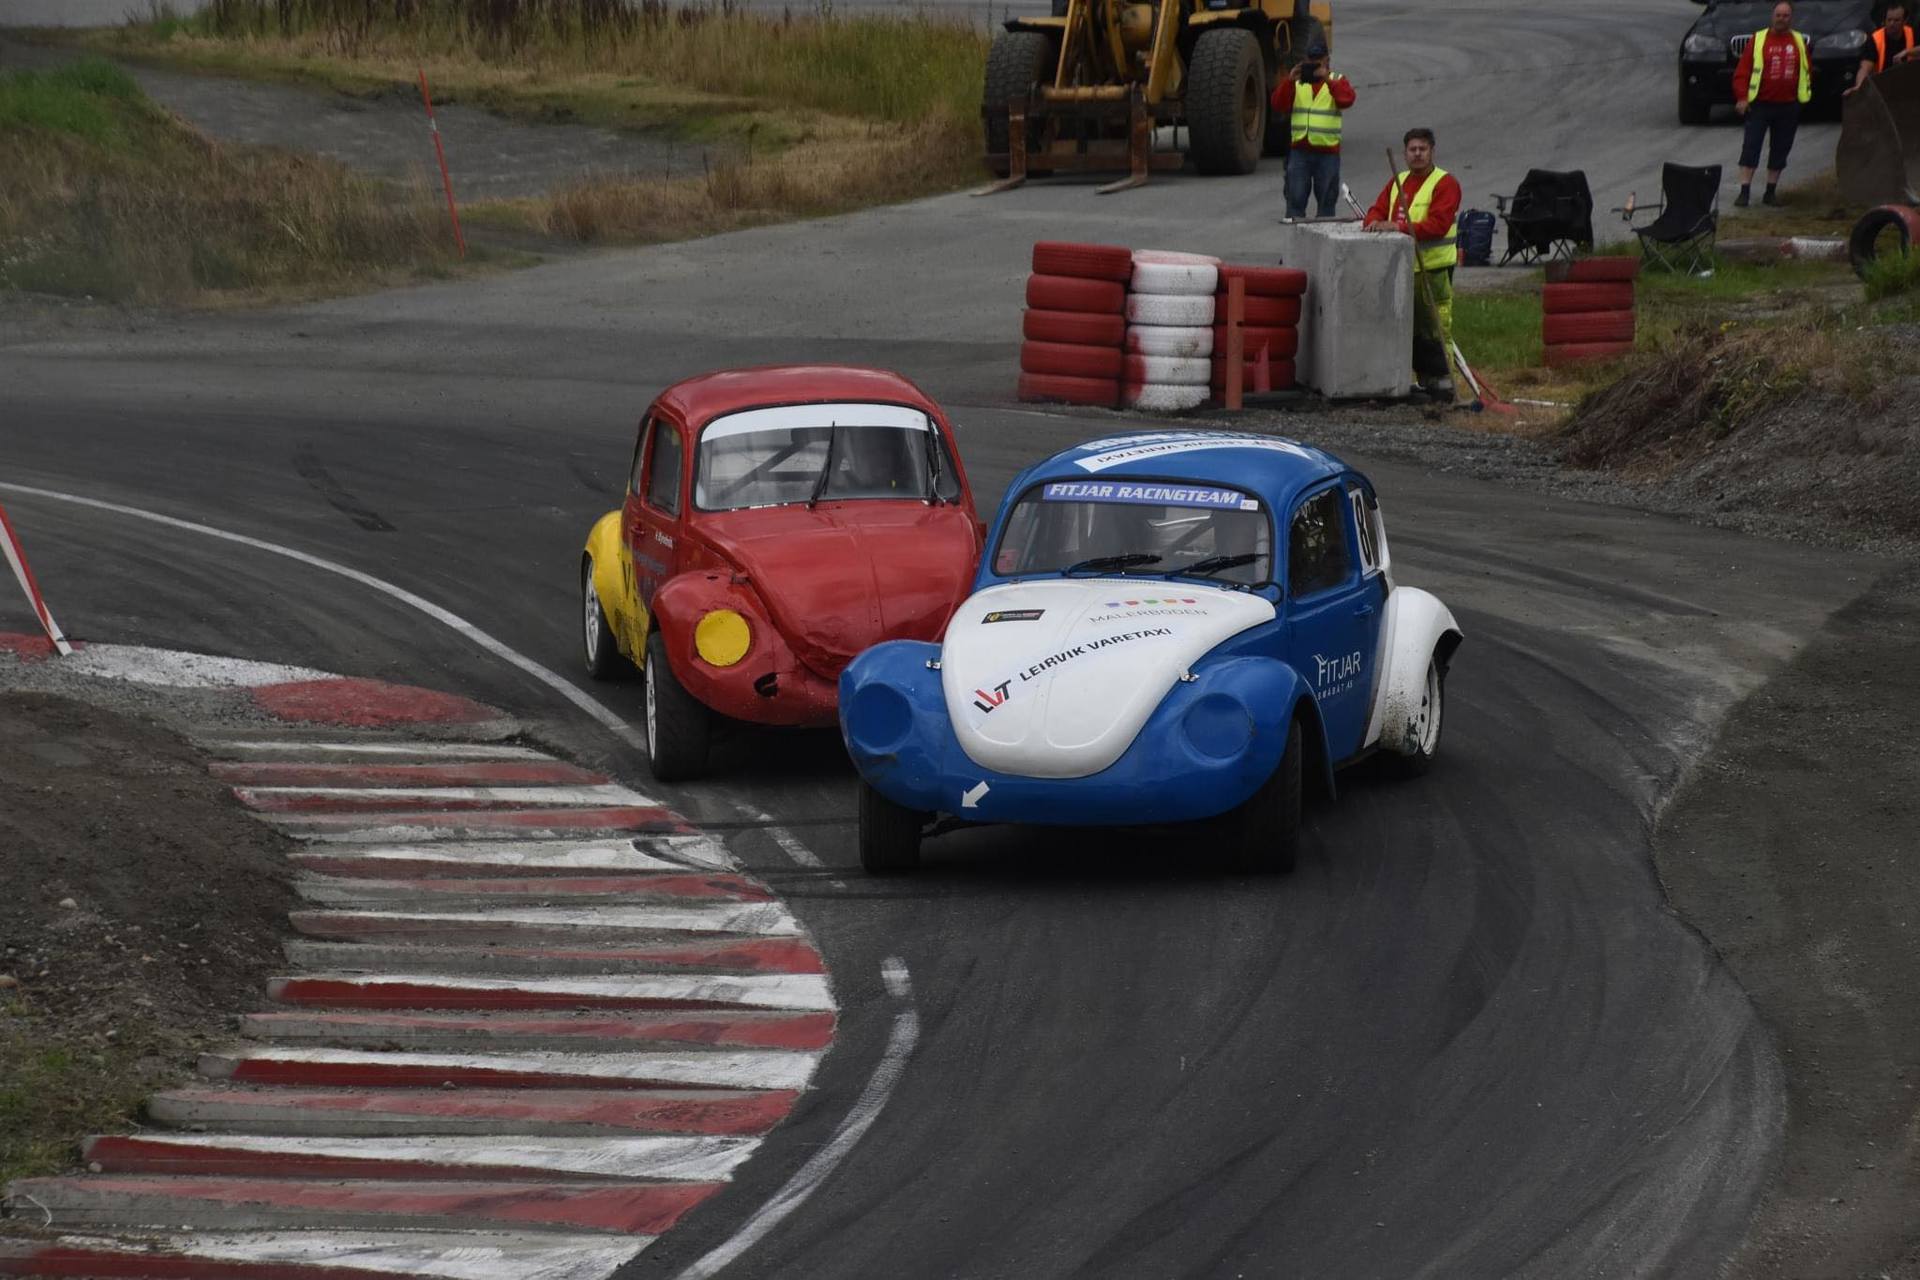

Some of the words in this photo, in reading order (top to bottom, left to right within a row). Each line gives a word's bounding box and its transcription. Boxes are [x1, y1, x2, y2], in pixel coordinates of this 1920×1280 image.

[1049, 483, 1112, 498] FITJAR
[1115, 487, 1240, 504] RACINGTEAM
[1356, 493, 1372, 566] 8
[972, 679, 1012, 714] LVT
[1019, 646, 1086, 682] LEIRVIK
[1086, 627, 1173, 651] VARETAXI
[1312, 651, 1361, 688] FITJAR
